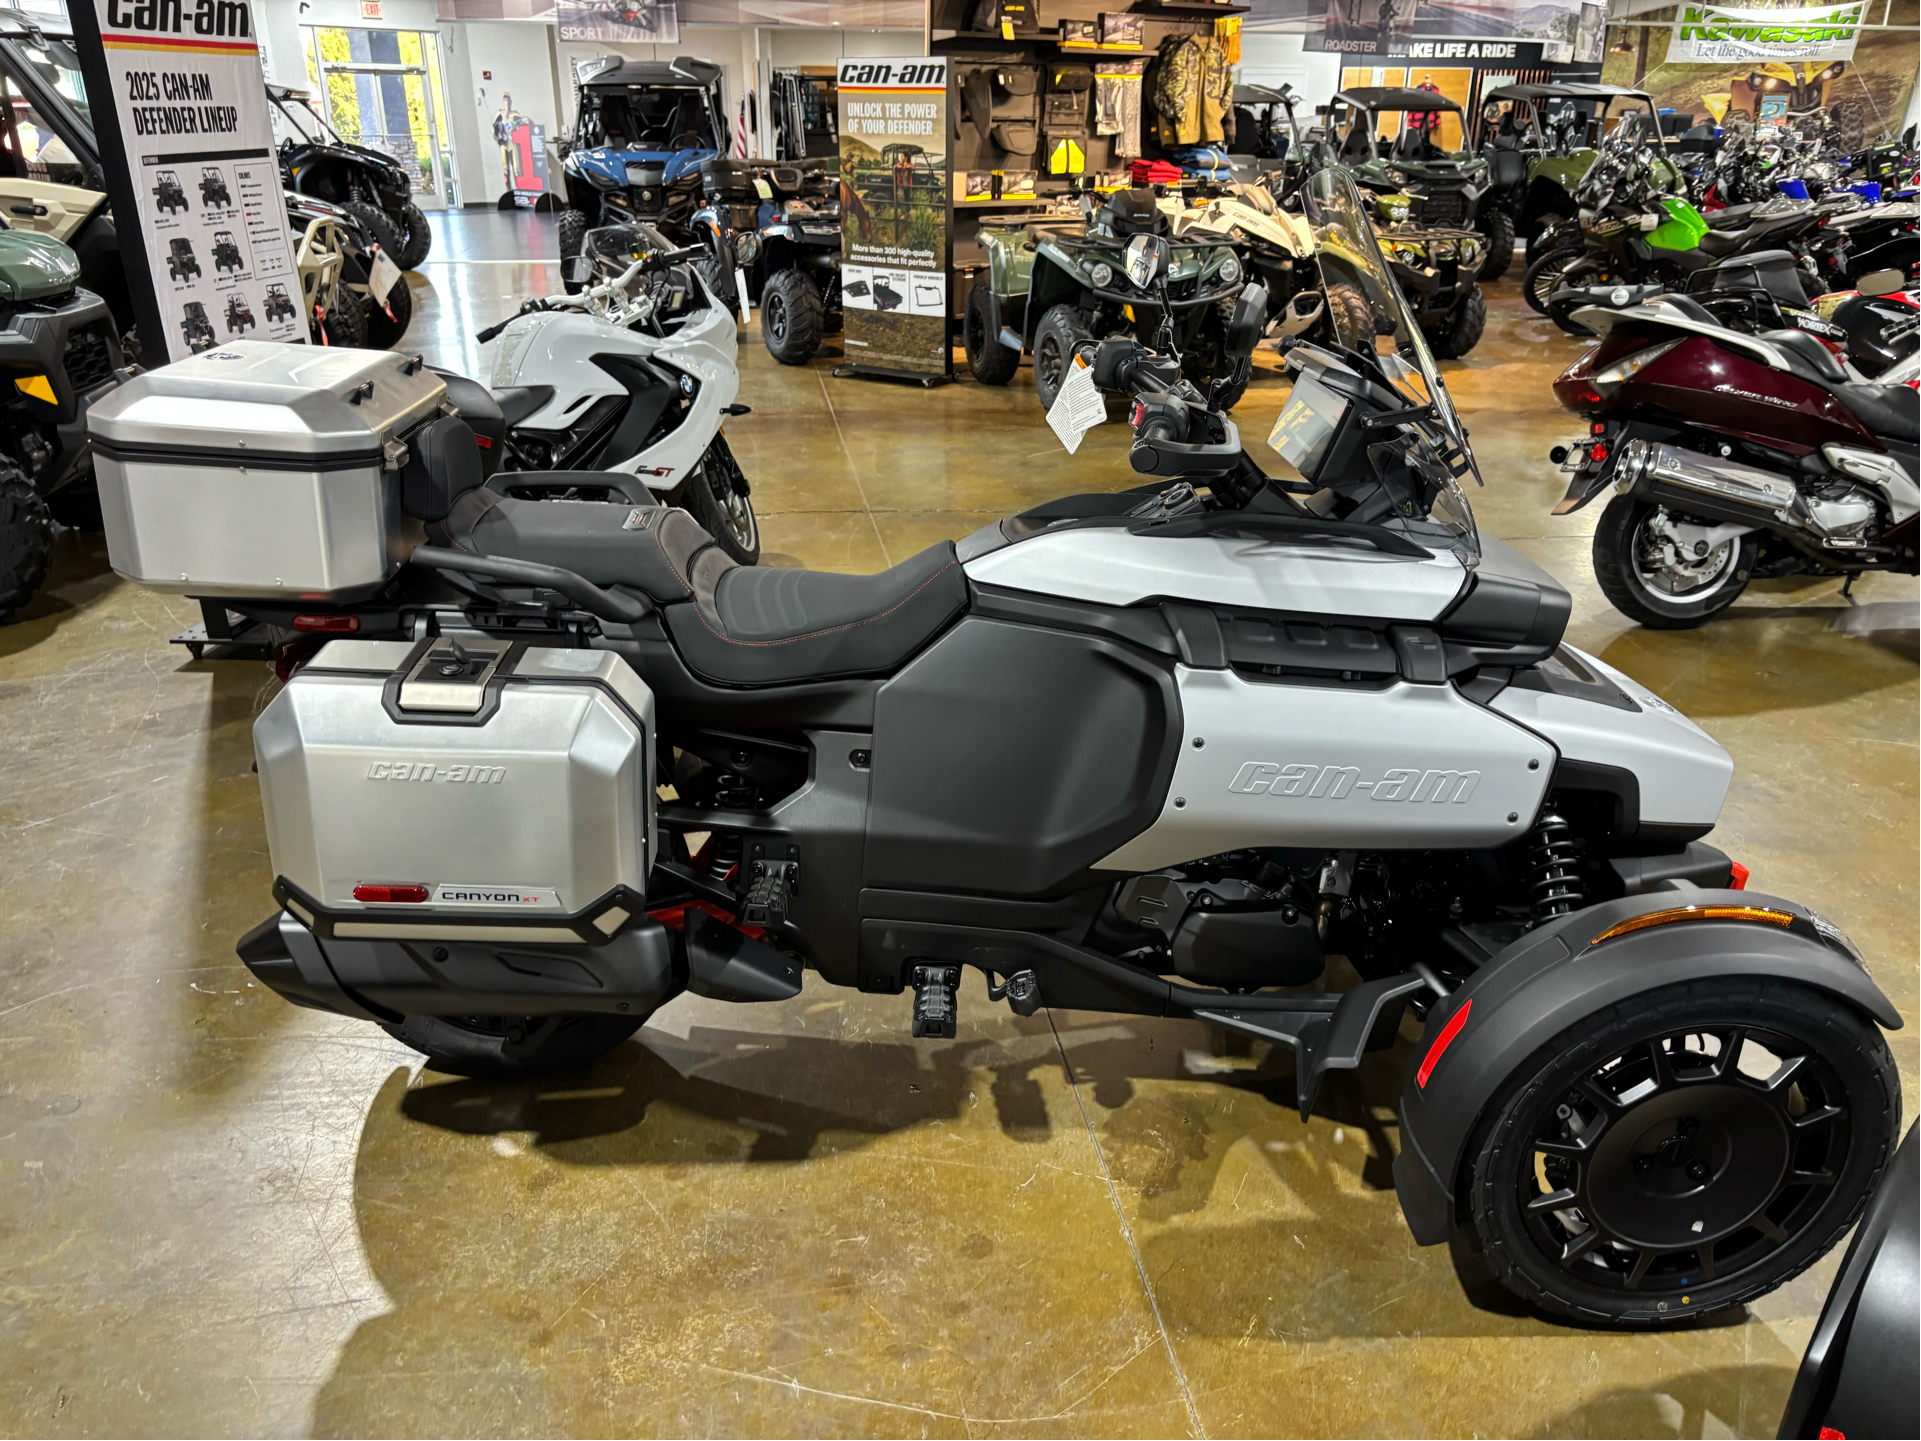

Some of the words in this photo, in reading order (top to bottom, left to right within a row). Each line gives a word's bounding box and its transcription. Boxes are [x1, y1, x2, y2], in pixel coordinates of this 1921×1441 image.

[365, 3, 379, 16] EXIT
[107, 0, 251, 38] can-am
[1679, 6, 1862, 43] Kawasaki
[560, 26, 603, 40] SPORT
[1325, 39, 1377, 52] ROADSTER
[1434, 43, 1465, 58] LIFE
[1466, 43, 1480, 58] A
[1481, 43, 1517, 58] RIDE
[1696, 43, 1715, 57] Let
[1717, 43, 1736, 57] the
[840, 64, 946, 84] can-am
[126, 70, 160, 102] 2025
[162, 72, 213, 101] CAN-AM
[847, 102, 883, 118] UNLOCK
[884, 103, 903, 118] THE
[904, 103, 937, 118] POWER
[132, 106, 198, 136] DEFENDER
[198, 106, 238, 134] LINEUP
[847, 118, 859, 133] OF
[861, 118, 885, 134] YOUR
[887, 120, 933, 135] DEFENDER
[851, 243, 869, 253] More
[869, 245, 884, 254] than
[884, 246, 897, 255] 300
[897, 247, 935, 259] high-quality
[850, 253, 887, 264] accessories
[887, 256, 900, 265] that
[900, 257, 908, 265] fit
[908, 258, 937, 269] perfectly
[1797, 317, 1830, 336] VORTEX
[1764, 395, 1799, 408] WING
[367, 761, 507, 784] can-am
[1228, 761, 1482, 804] can-am
[441, 892, 520, 901] CANYON
